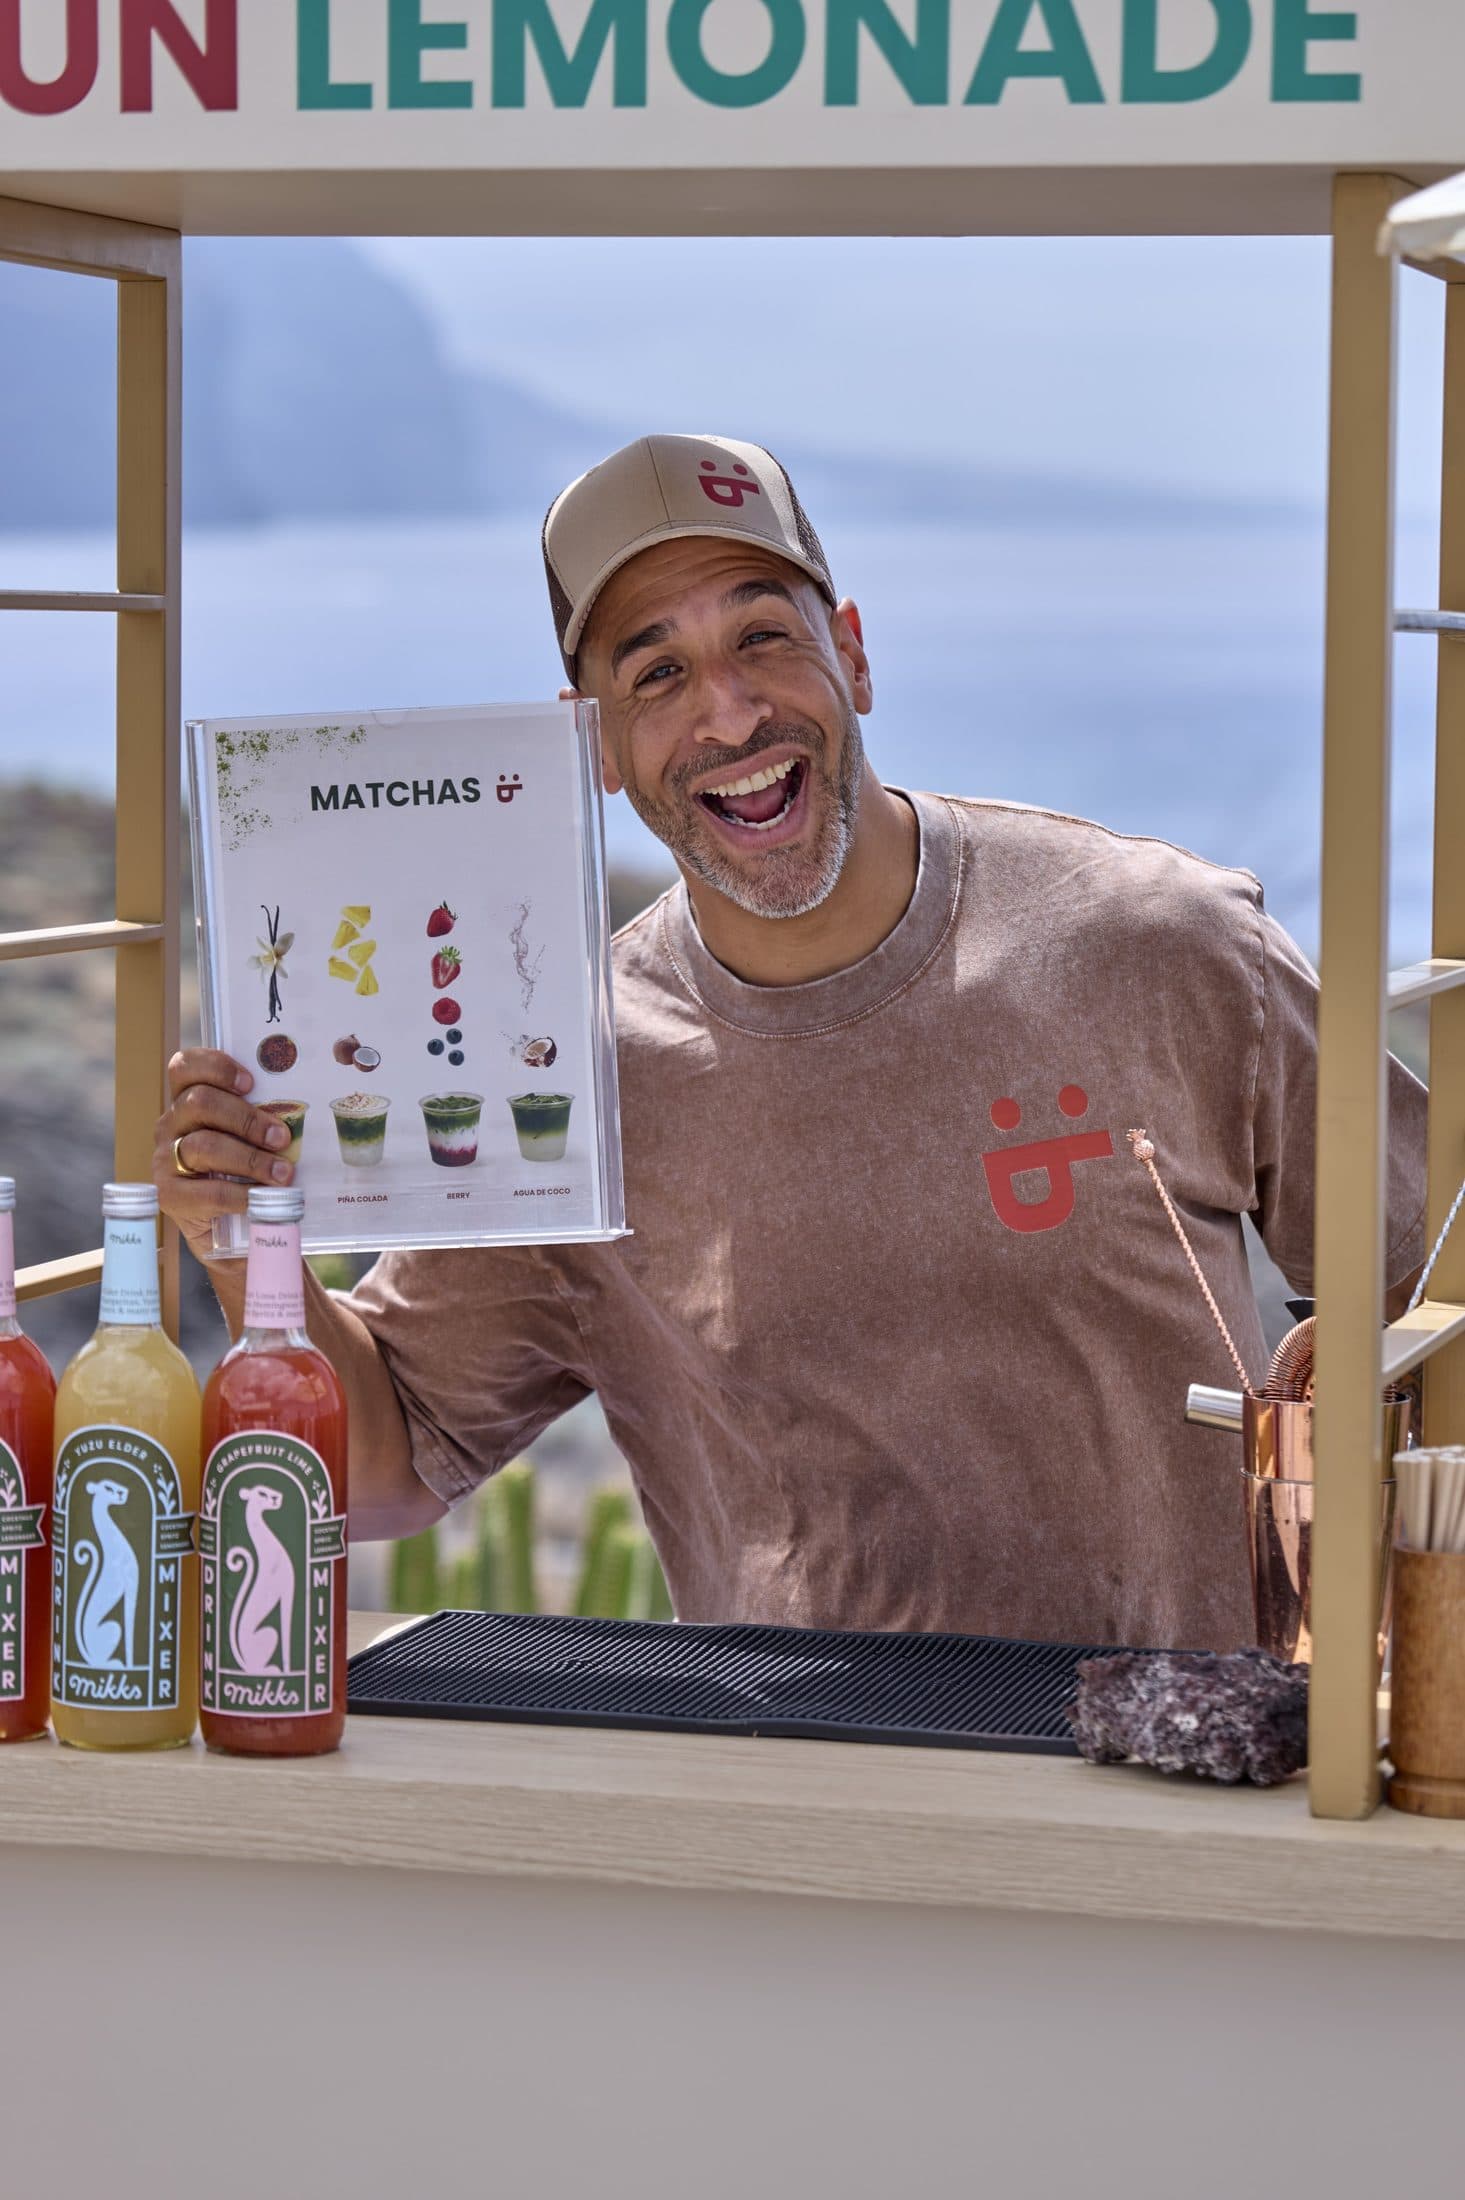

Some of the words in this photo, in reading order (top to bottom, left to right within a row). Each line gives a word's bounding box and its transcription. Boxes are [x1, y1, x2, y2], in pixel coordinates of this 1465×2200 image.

[296, 0, 1361, 112] LEMONADE
[310, 777, 481, 812] MATCHAS
[337, 1195, 355, 1204] PIÑA
[356, 1194, 388, 1203] COLADA
[446, 1191, 470, 1200] BERRY
[513, 1189, 535, 1197] AGUA
[536, 1188, 547, 1196] DE
[547, 1187, 571, 1196] COCO
[74, 1439, 103, 1457] YUZU
[108, 1439, 148, 1460] ELDER
[216, 1444, 285, 1474] GRAPEFRUIT
[287, 1450, 314, 1476] LIME
[1, 1556, 18, 1689] MIXER
[53, 1557, 64, 1693] DRINK
[158, 1563, 176, 1699] MIXER
[204, 1565, 215, 1701] DRINK
[313, 1567, 329, 1703] MIXER
[68, 1671, 143, 1701] mikks
[223, 1679, 300, 1706] mikks
